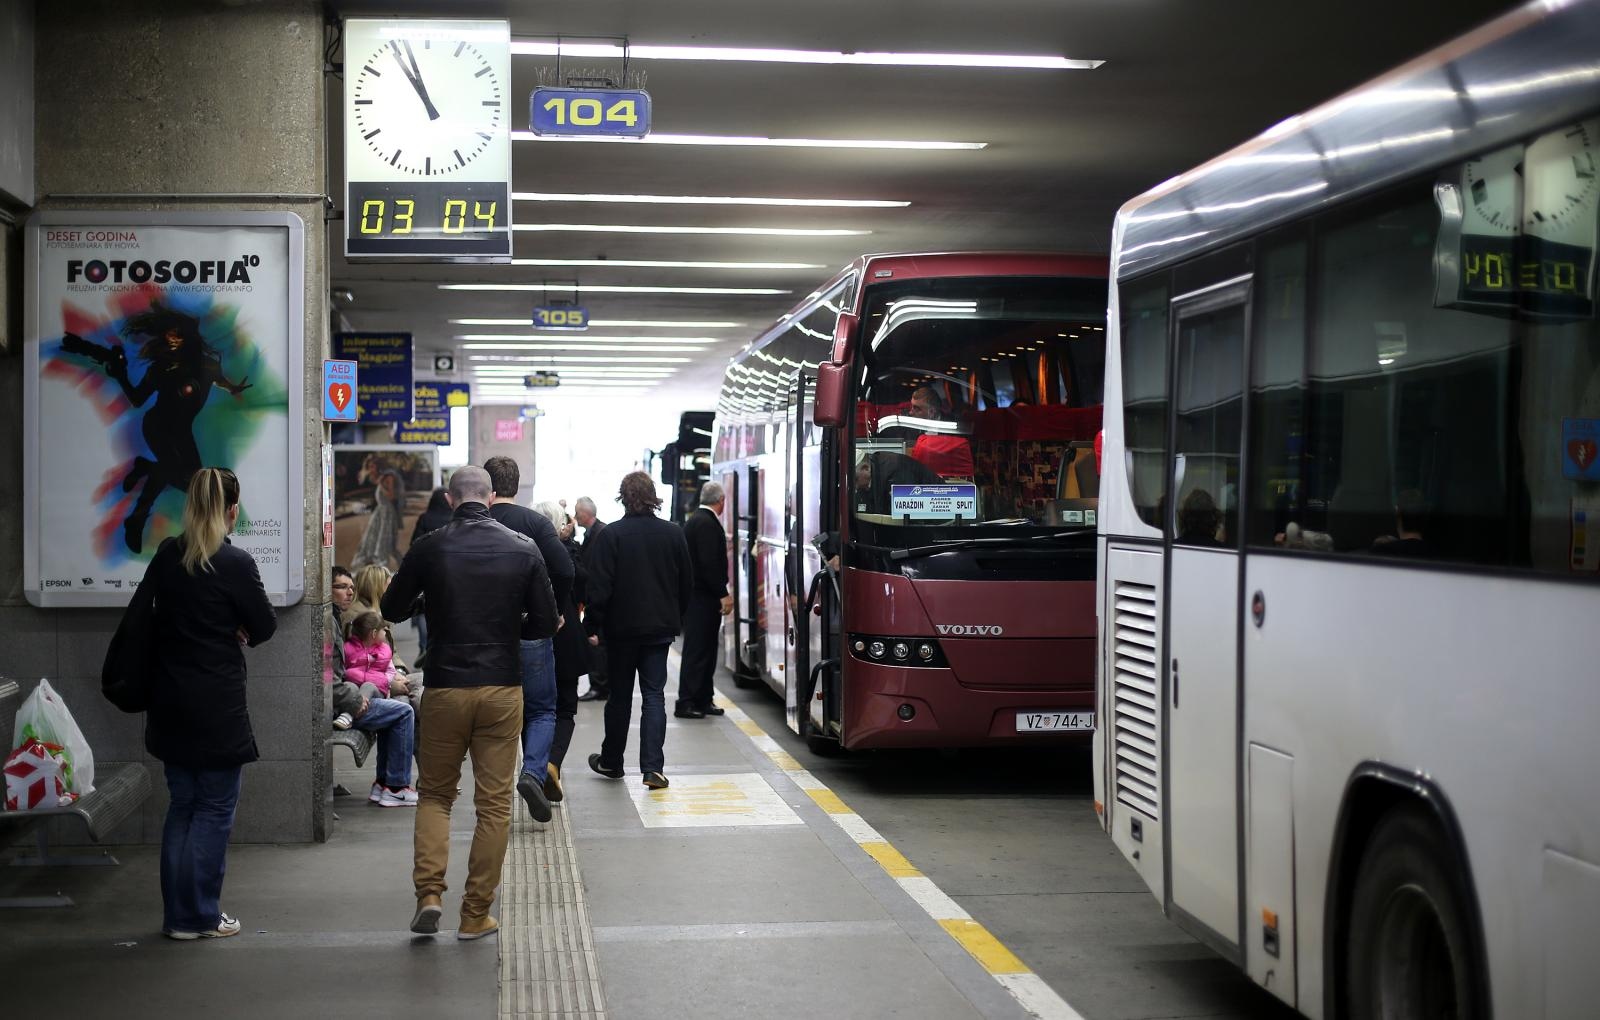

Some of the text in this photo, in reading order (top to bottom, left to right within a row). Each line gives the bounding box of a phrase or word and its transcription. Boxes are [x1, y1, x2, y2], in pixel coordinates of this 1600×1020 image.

[543, 98, 638, 126] 104
[360, 200, 497, 234] 03 04
[47, 231, 137, 241] DESET GODINA
[67, 254, 260, 284] FOTOSOFIA 10
[538, 310, 583, 325] 105
[331, 364, 351, 374] AED
[400, 432, 449, 443] SERVICE
[895, 498, 924, 509] VARAŽDIN
[956, 501, 973, 509] SPLIT
[248, 518, 281, 527] NATJEČAJ
[936, 624, 1003, 635] VOLVO
[1026, 714, 1095, 729] VZ 744-J
